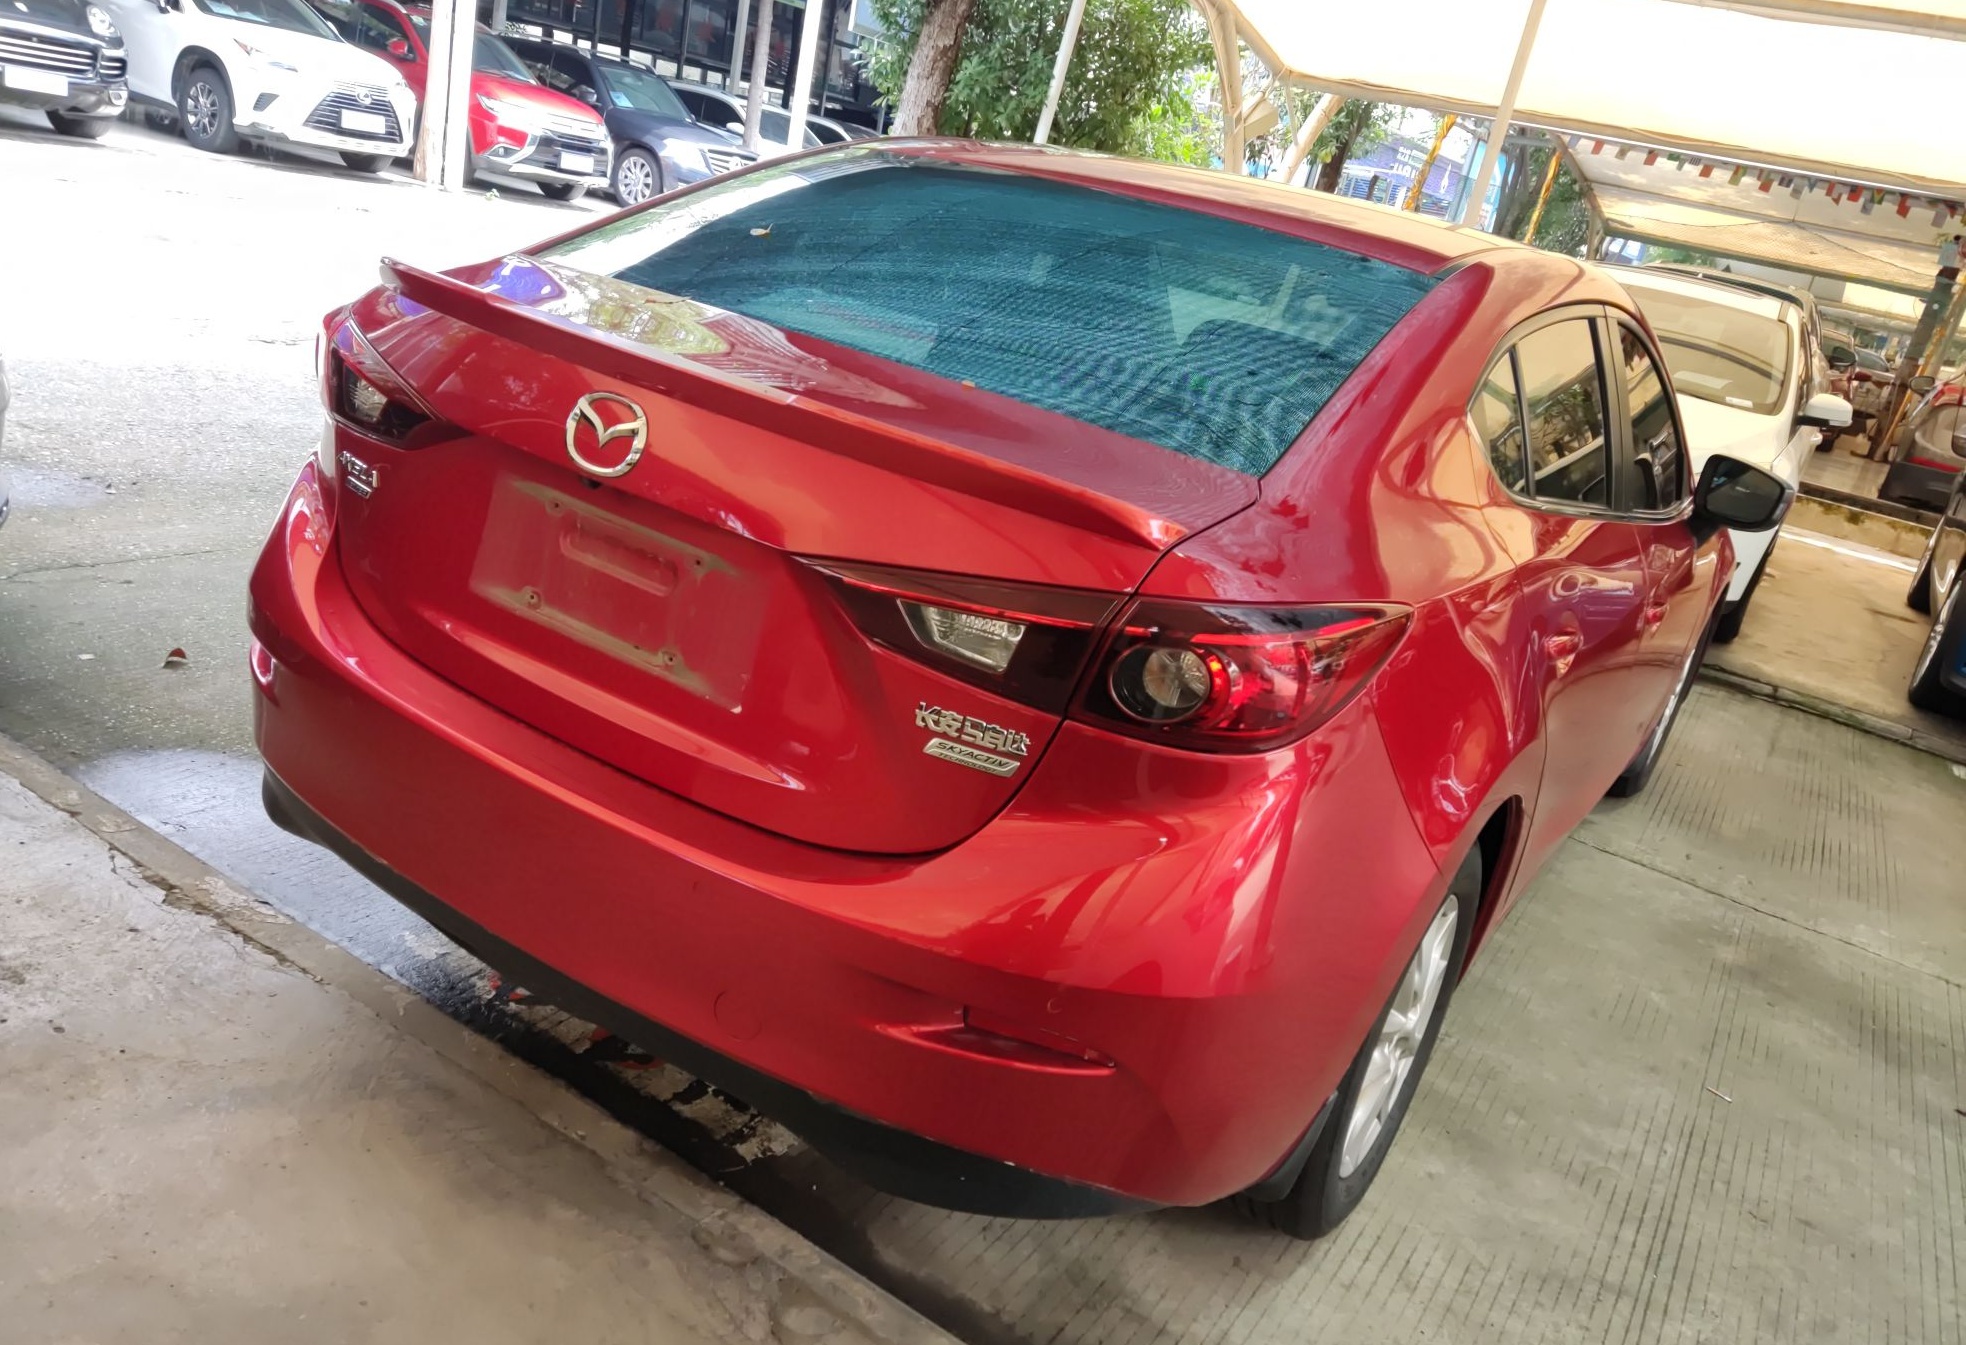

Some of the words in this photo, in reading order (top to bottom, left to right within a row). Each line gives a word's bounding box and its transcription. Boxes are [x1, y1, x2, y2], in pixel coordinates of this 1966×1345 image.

[915, 701, 1031, 756] 长安马自达
[936, 741, 1011, 768] SKYACTIV
